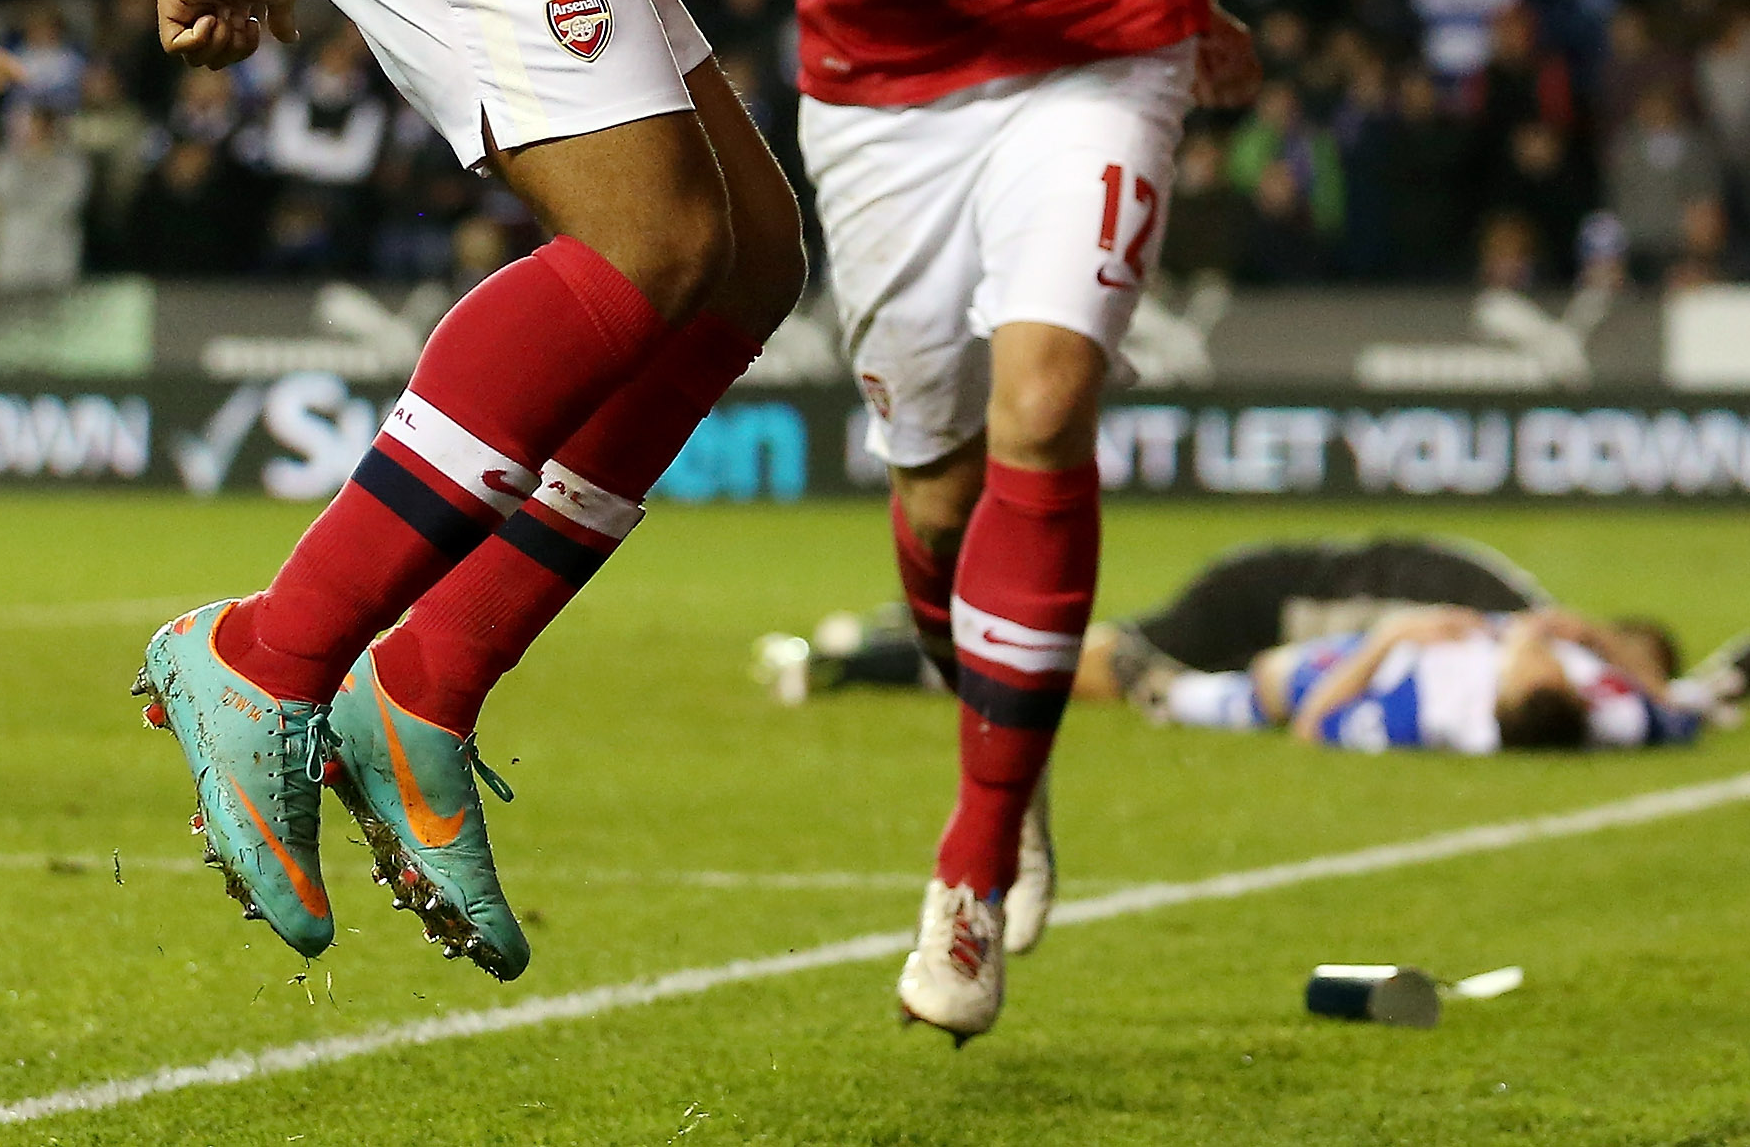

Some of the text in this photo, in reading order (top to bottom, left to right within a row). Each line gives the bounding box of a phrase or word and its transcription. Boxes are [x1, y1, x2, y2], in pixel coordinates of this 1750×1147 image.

[1099, 164, 1158, 280] 12
[1194, 406, 1335, 494] LET
[1339, 406, 1511, 495] YOU
